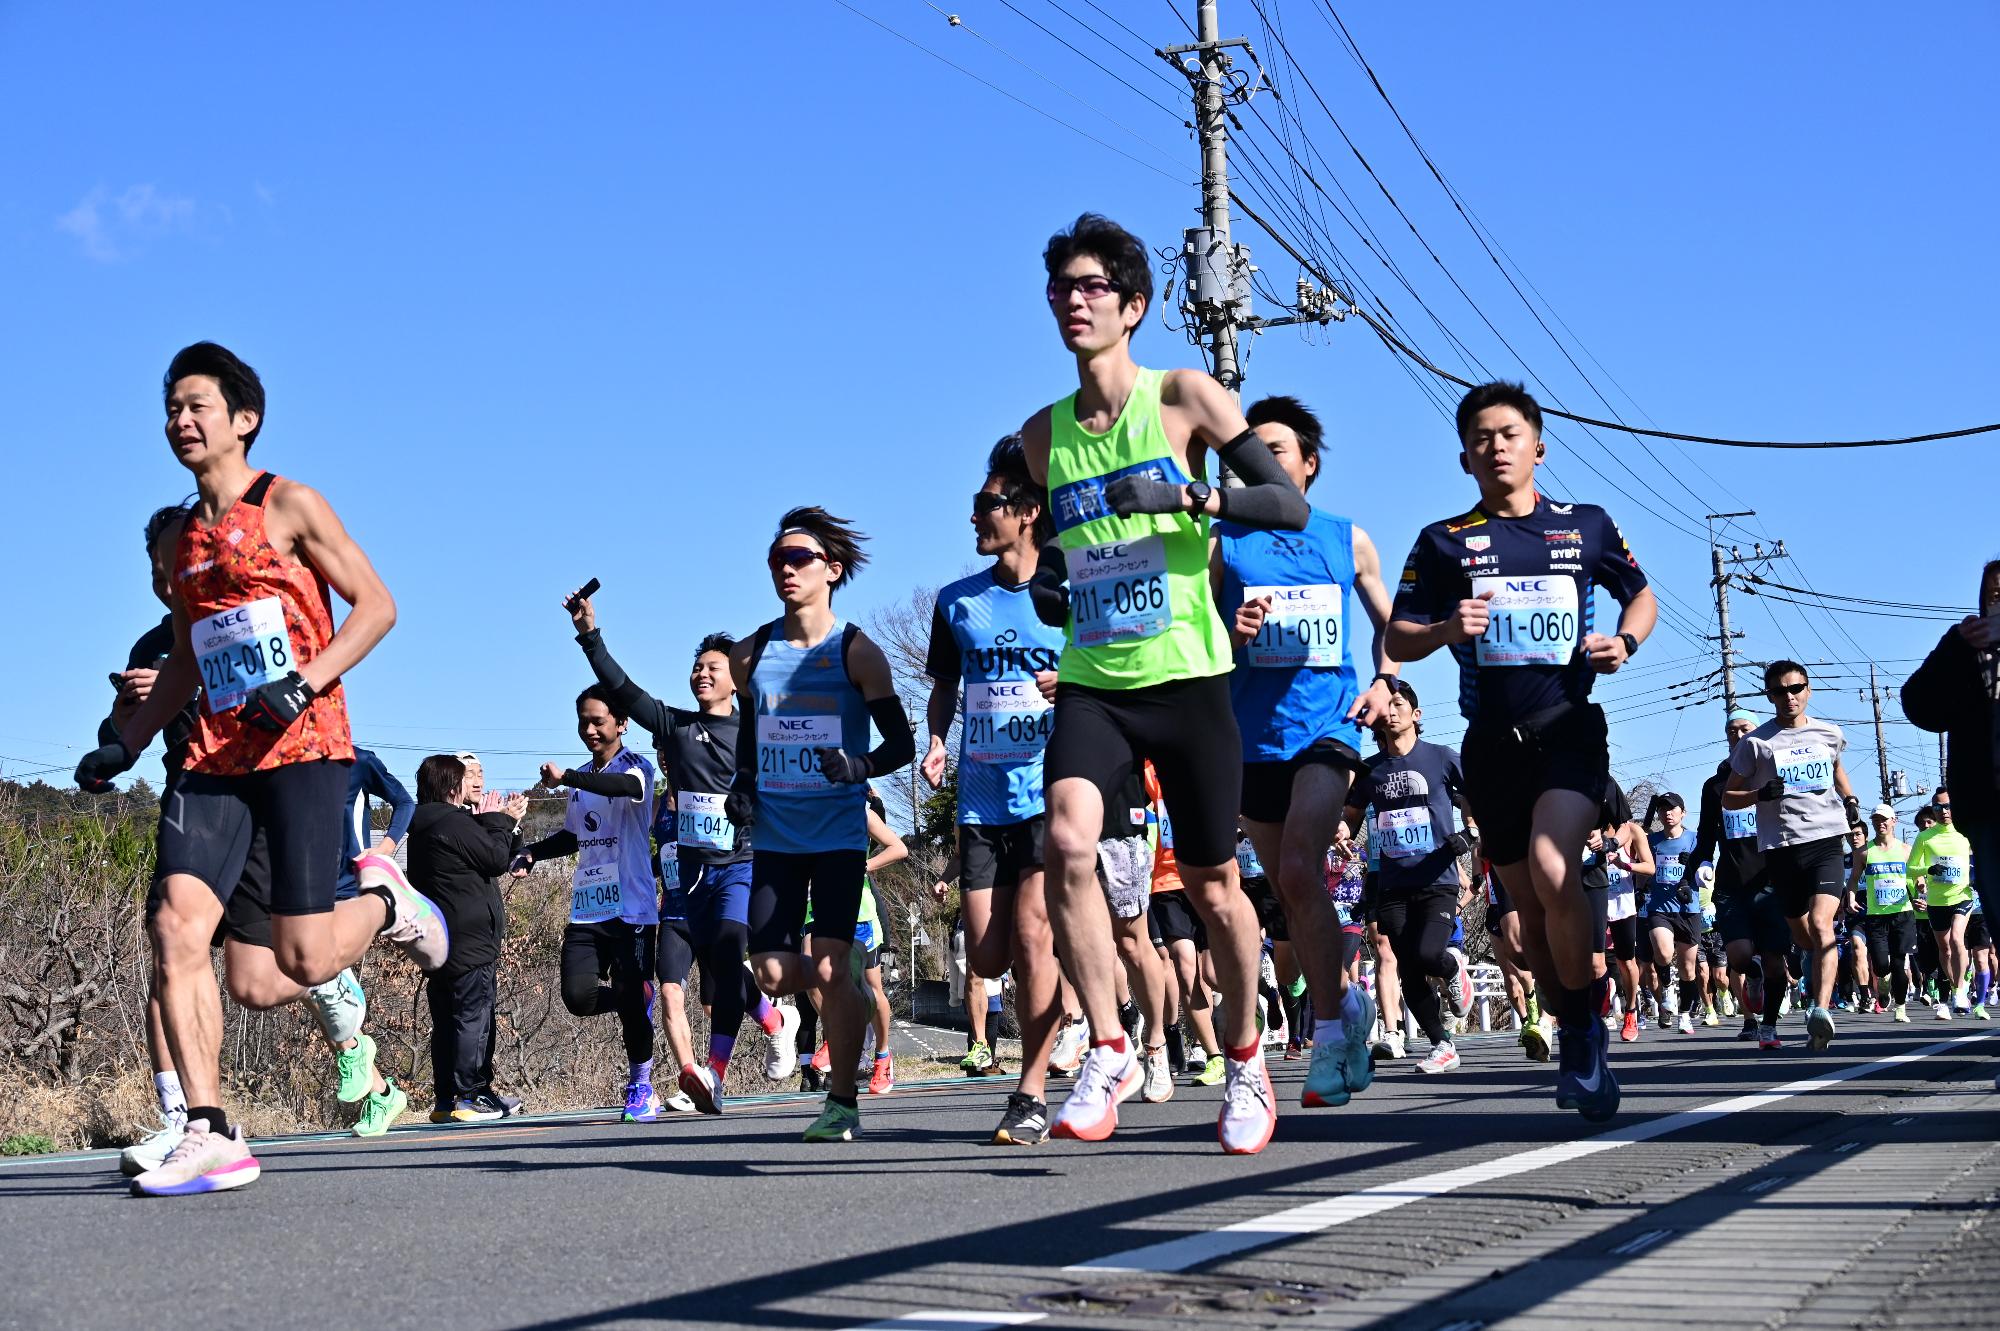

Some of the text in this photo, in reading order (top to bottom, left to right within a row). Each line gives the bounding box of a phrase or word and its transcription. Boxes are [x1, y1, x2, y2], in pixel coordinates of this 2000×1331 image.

[1087, 544, 1128, 563] NEC
[1460, 556, 1488, 567] Mobil
[1549, 564, 1582, 572] HONDA
[1506, 580, 1548, 592] NEC
[1073, 576, 1165, 624] 211-066
[1274, 589, 1312, 600] NEC
[212, 609, 248, 631] NEC
[1480, 612, 1574, 643] 211-060
[203, 636, 287, 691] 212-018
[987, 686, 1024, 697] NEC
[779, 720, 814, 730] NEC
[969, 714, 1051, 745] 211-034
[1790, 747, 1813, 756] NEC
[761, 746, 823, 774] 211-03
[1387, 771, 1408, 782] THE
[1780, 762, 1829, 784] 212-021
[1375, 780, 1408, 794] NORTH
[692, 795, 716, 804] NEC
[1384, 788, 1410, 800] FACE
[1389, 811, 1412, 820] NEC
[1725, 812, 1757, 830] 211-0
[680, 813, 732, 837] 211-047
[1380, 826, 1428, 848] 212-017
[584, 867, 604, 877] NEC
[1656, 866, 1683, 877] 211-00
[574, 884, 620, 911] 211-048
[1875, 888, 1905, 899] 211-023
